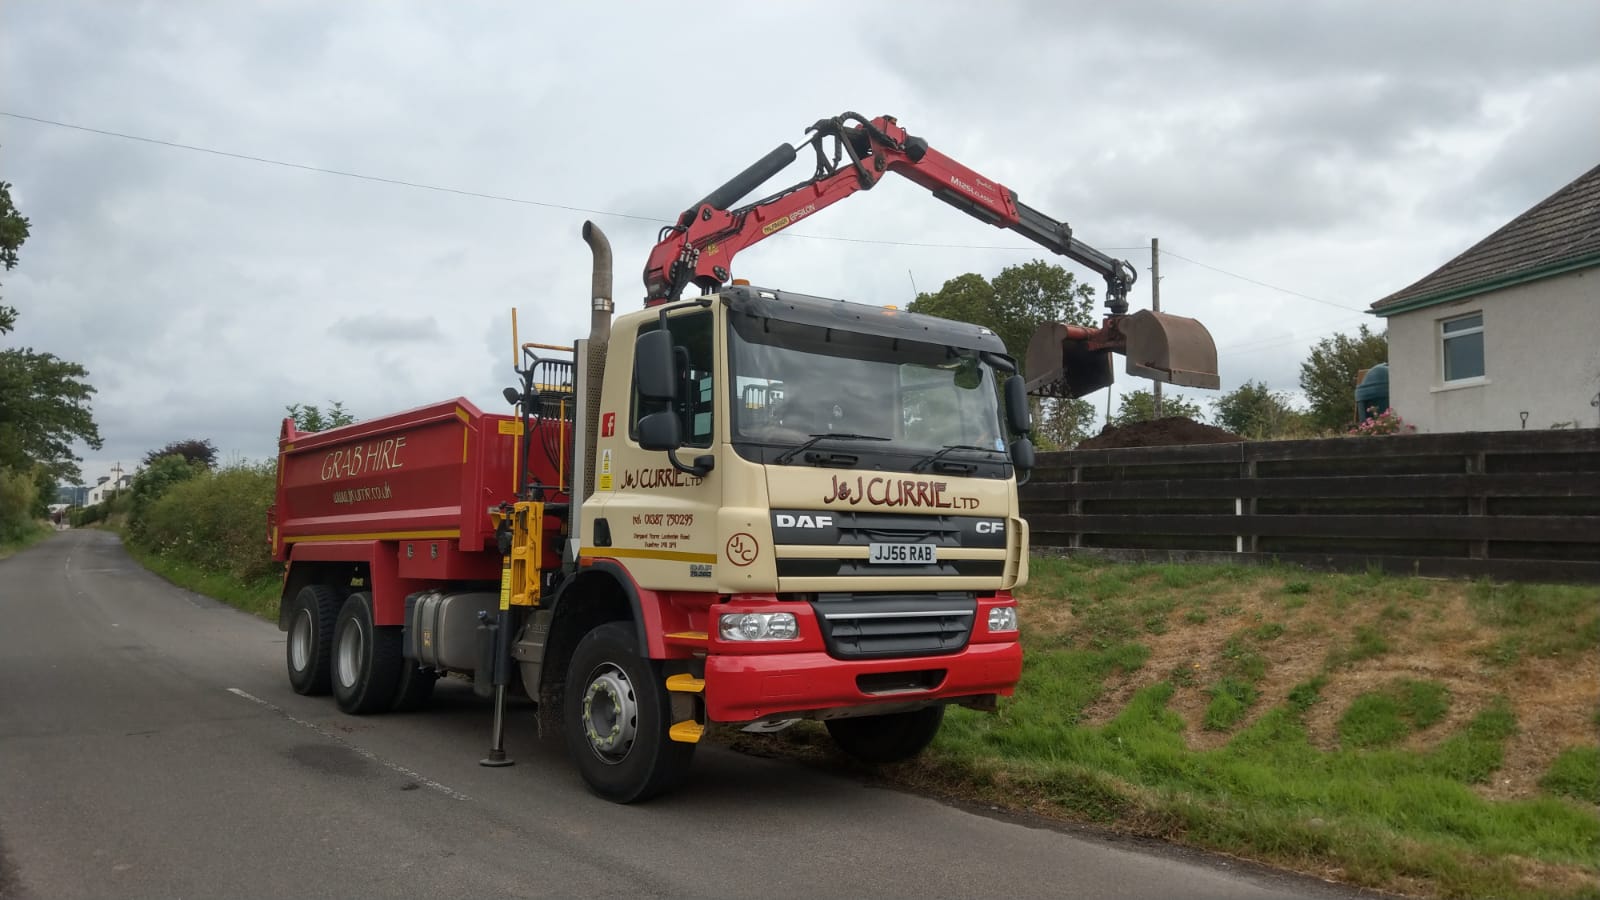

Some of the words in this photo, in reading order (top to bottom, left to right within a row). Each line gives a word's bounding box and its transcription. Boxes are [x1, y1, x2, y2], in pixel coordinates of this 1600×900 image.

[789, 204, 816, 221] EPSILON
[321, 445, 363, 480] GRAB
[363, 436, 407, 473] HIRE
[640, 468, 684, 489] CURRIE
[685, 477, 703, 487] LTD
[823, 475, 863, 505] J&J
[866, 477, 952, 508] CURRIE
[952, 496, 980, 510] LTD
[644, 513, 664, 527] 01387
[666, 513, 694, 527] 750295
[776, 514, 833, 529] DAF
[975, 521, 1005, 534] CF
[874, 546, 907, 561] JJ56
[909, 547, 932, 561] RAB
